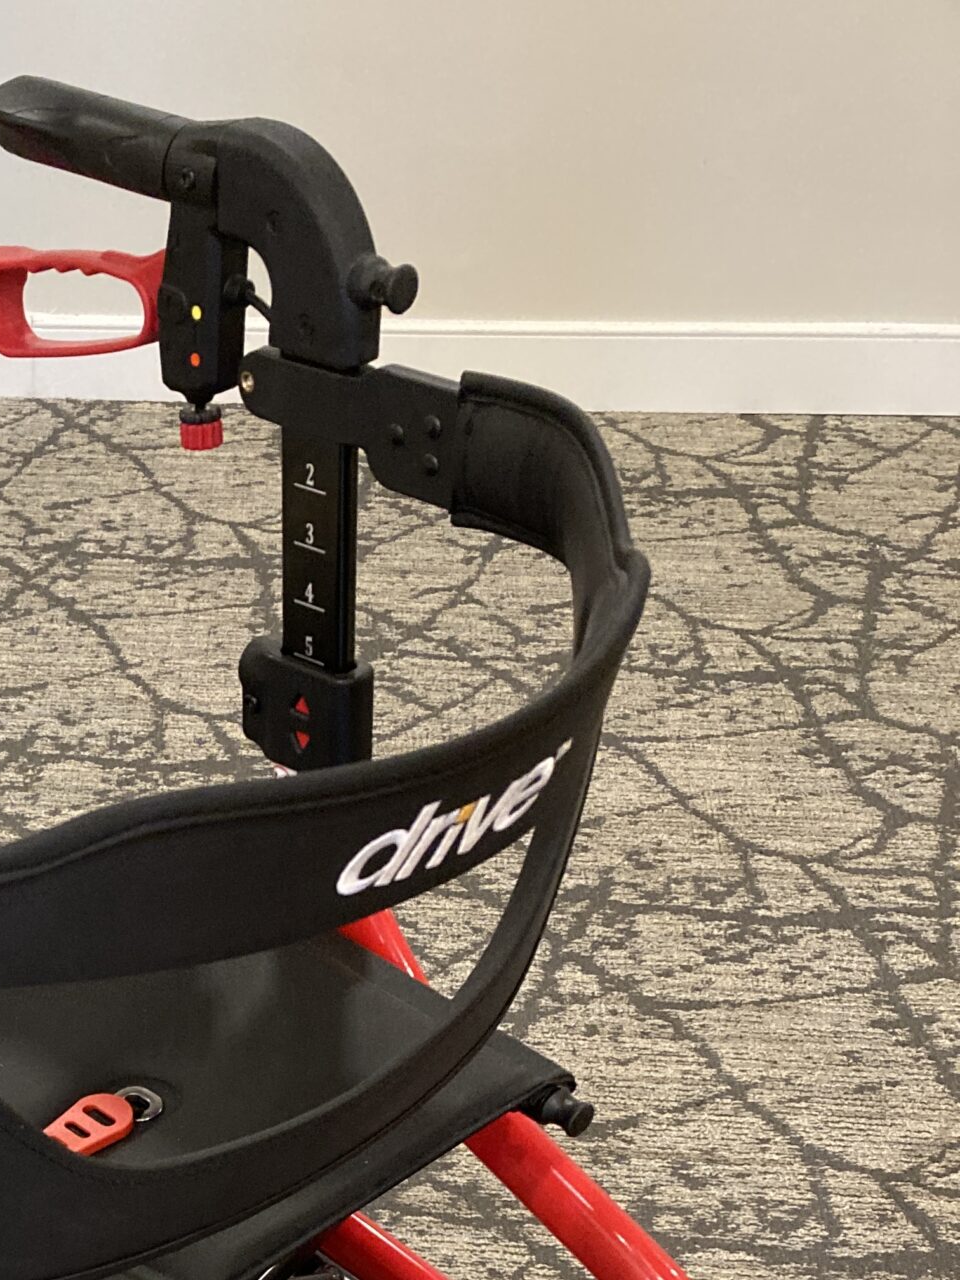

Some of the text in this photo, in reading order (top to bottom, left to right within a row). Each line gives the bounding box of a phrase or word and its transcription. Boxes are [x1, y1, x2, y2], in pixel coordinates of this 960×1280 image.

[305, 462, 315, 487] 2
[305, 522, 314, 546] 3
[304, 582, 314, 604] 4
[304, 635, 313, 657] 5
[336, 737, 573, 896] drive
